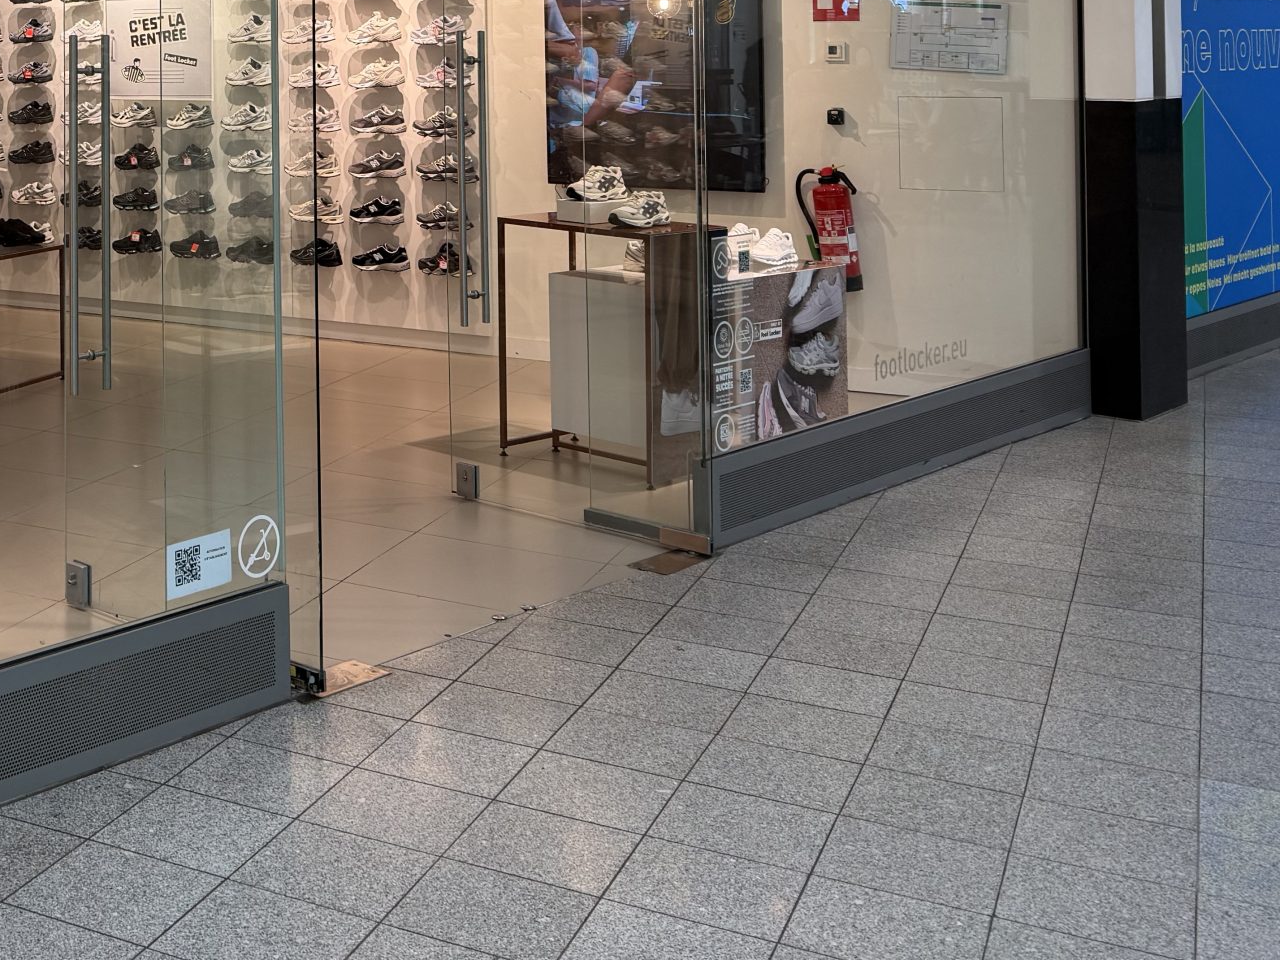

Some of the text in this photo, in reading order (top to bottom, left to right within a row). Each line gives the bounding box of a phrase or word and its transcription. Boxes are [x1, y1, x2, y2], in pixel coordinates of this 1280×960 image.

[168, 13, 185, 27] LA
[130, 27, 187, 48] RENTRÉE
[874, 339, 967, 381] footlocker.eu
